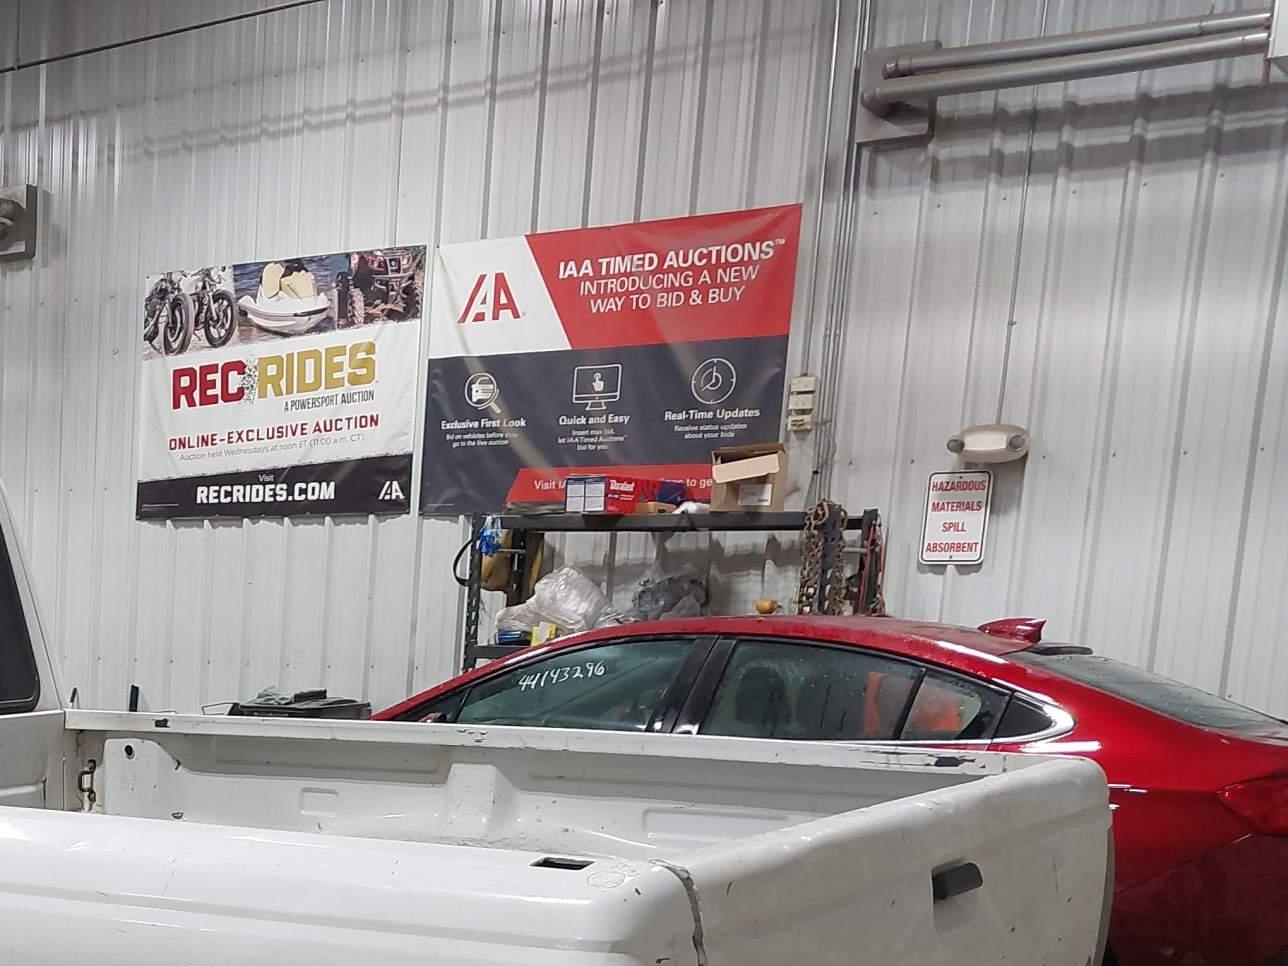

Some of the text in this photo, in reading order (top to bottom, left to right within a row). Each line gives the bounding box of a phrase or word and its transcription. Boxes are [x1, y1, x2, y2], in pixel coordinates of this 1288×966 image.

[558, 259, 594, 280] IAA
[597, 252, 658, 276] TIMED
[579, 264, 760, 296] INTRODUCING A NEW
[589, 285, 746, 314] WAY TO BID & BUY
[172, 341, 376, 411] REC RIDES
[283, 390, 376, 413] A POWERSPORT AUCTION
[559, 413, 631, 426] Quick and Easy
[664, 408, 761, 422] Real-Time Updates
[441, 417, 528, 431] Exclusive First Look
[719, 423, 748, 432] updates
[169, 414, 380, 451] ONLINE-EXCLUSIVE AUCTION
[684, 432, 704, 440] about
[179, 453, 206, 462] Auction
[207, 450, 224, 459] held
[224, 446, 270, 458] Wednesdays
[270, 444, 278, 452] at
[279, 443, 298, 452] noon
[258, 473, 275, 482] Visit
[534, 479, 558, 490] Visit
[686, 478, 697, 487] to
[699, 478, 712, 489] ge
[196, 481, 336, 504] RECRIDES.COM
[932, 480, 987, 492] HAZARDOUS
[931, 501, 983, 513] MATERIALS
[942, 521, 967, 532] SPILL
[925, 542, 979, 553] ABSORBENT
[518, 660, 606, 692] 44143296
